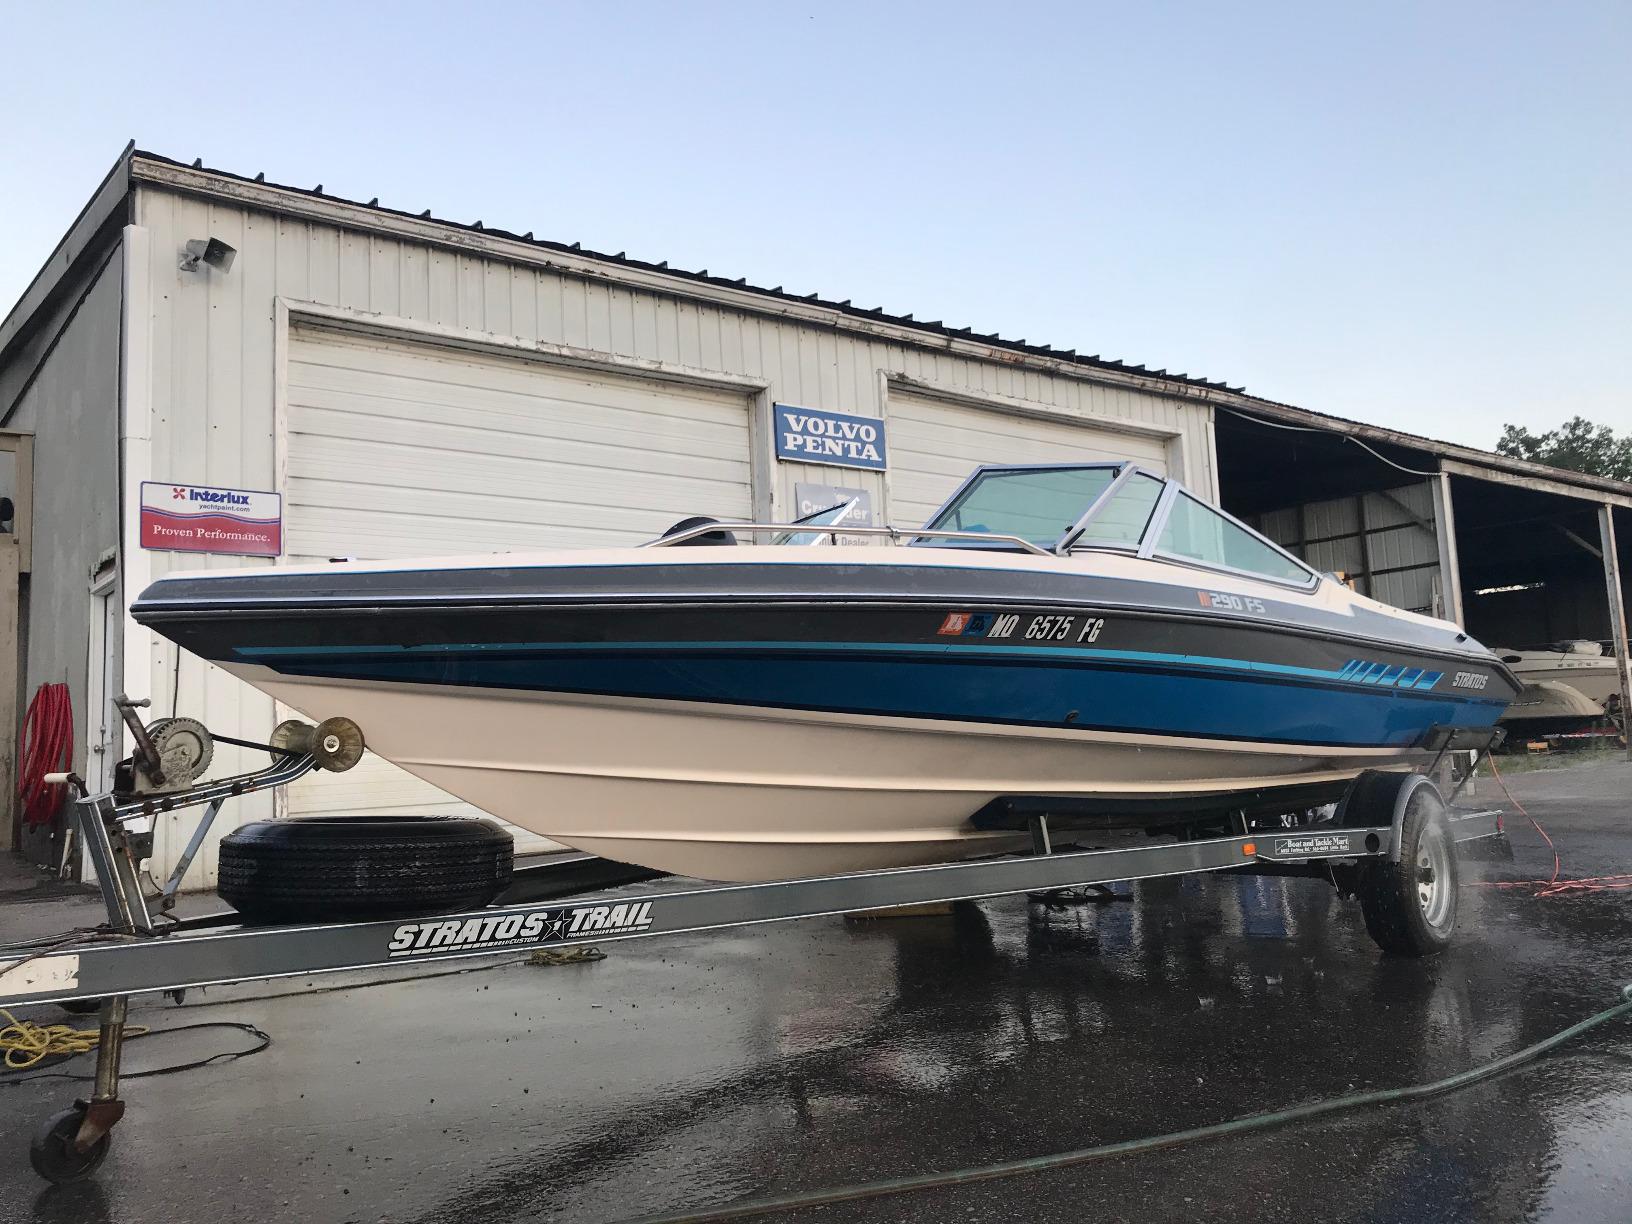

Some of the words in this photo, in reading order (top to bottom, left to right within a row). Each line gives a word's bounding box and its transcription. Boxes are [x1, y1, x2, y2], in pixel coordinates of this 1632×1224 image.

[783, 413, 877, 443] VOLVO
[783, 433, 882, 462] PENTA
[190, 489, 249, 505] Interlux
[199, 503, 250, 513] yachtpaint.com
[153, 524, 194, 537] Proven
[196, 527, 271, 542] Performance.
[1209, 592, 1243, 611] 290
[1244, 597, 1266, 613] FS
[986, 613, 1020, 638] MO
[1024, 615, 1075, 640] 6575
[1076, 618, 1105, 643] FG
[1452, 671, 1489, 690] STRATOS
[1287, 839, 1302, 848] Boat
[1303, 838, 1314, 847] and
[1333, 837, 1348, 846] Mart
[388, 912, 548, 950] STRATOS
[569, 901, 654, 932] TRAIL
[511, 936, 539, 945] CUSTOM
